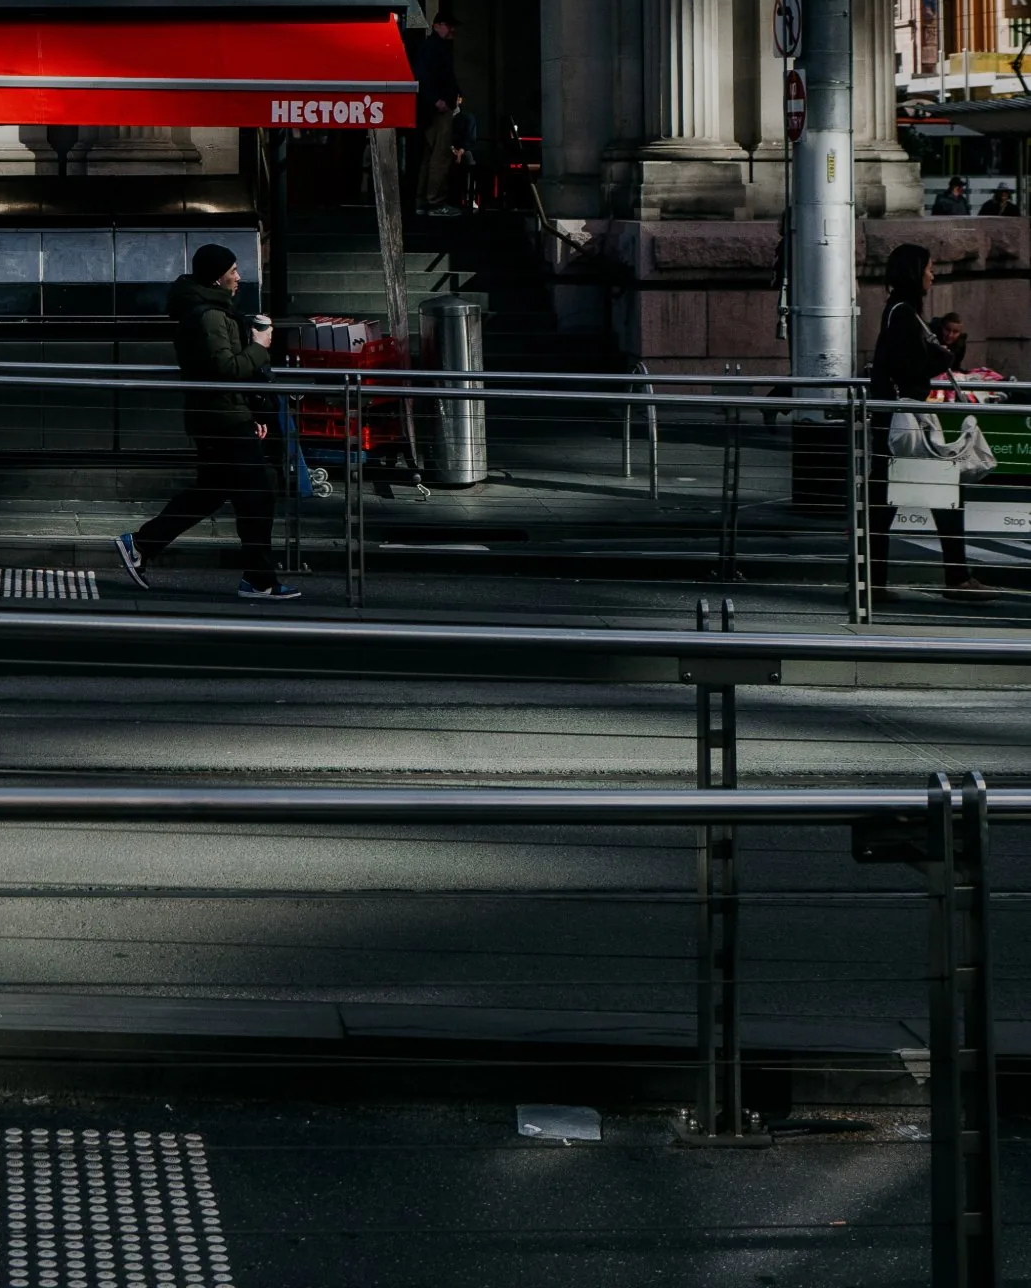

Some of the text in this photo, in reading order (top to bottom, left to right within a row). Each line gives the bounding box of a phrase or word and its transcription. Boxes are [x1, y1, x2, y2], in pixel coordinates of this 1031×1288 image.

[271, 94, 384, 124] HECTOR'S
[895, 513, 928, 525] To City
[1004, 516, 1026, 527] Stop
